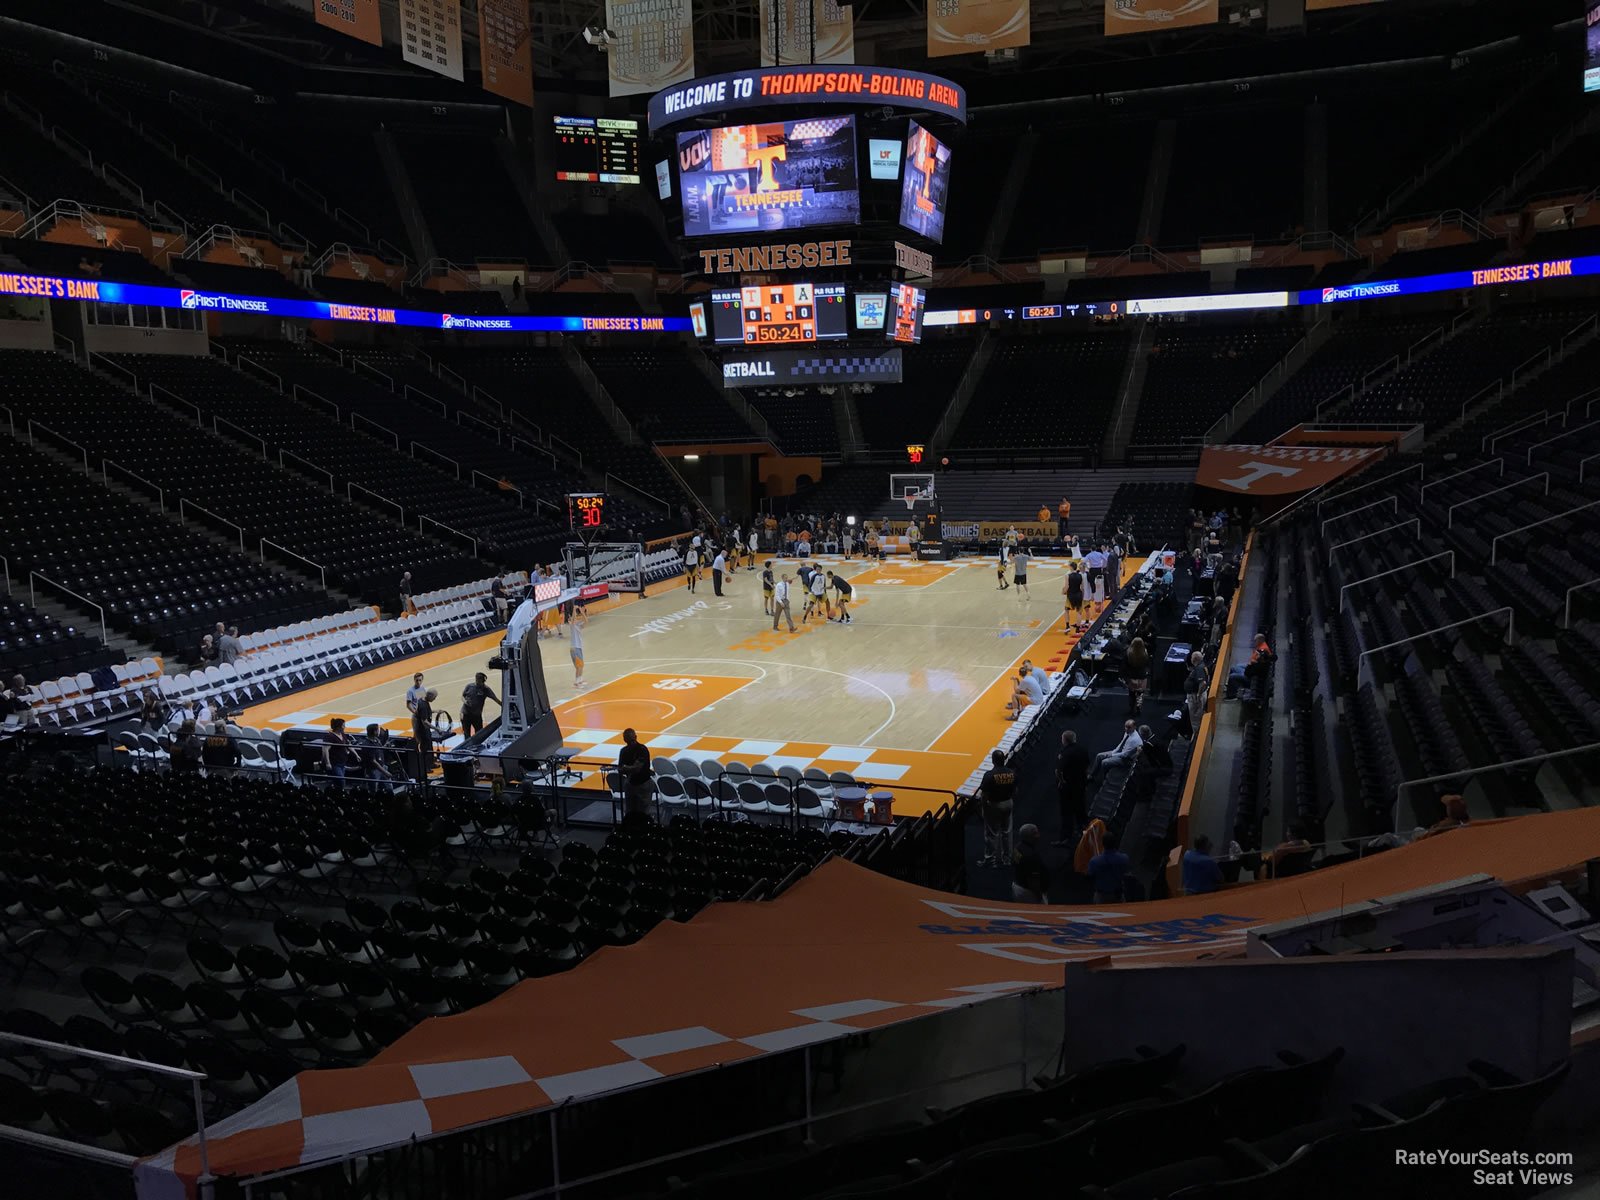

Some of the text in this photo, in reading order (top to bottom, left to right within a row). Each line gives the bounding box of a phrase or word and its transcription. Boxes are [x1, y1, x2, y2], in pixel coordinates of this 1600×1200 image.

[612, 0, 684, 17] TOURNAMENT
[614, 7, 685, 28] CHAMPIONS
[665, 73, 960, 115] WELCOME TO THOMPSON-BOLING ARENA
[736, 190, 803, 207] TENNESSEE
[728, 200, 813, 213] BASKETBALL
[700, 239, 852, 274] TENNESSEE
[1472, 260, 1572, 286] TENNESSEE'S BANK
[67, 280, 99, 299] BANK
[799, 287, 808, 301] A
[1334, 287, 1353, 299] FIRST
[195, 294, 218, 307] FIRST
[329, 304, 396, 323] TENNESSEE'S BANK
[801, 307, 808, 318] 0
[1029, 307, 1055, 317] 50:24
[1110, 303, 1118, 313] 0
[749, 310, 757, 320] 0
[983, 310, 991, 320] 0
[451, 317, 465, 328] FIRST
[582, 317, 664, 330] TENNESSEE'S BANK
[760, 326, 800, 341] 50:24
[577, 497, 603, 509] 50:24
[583, 507, 600, 527] 30
